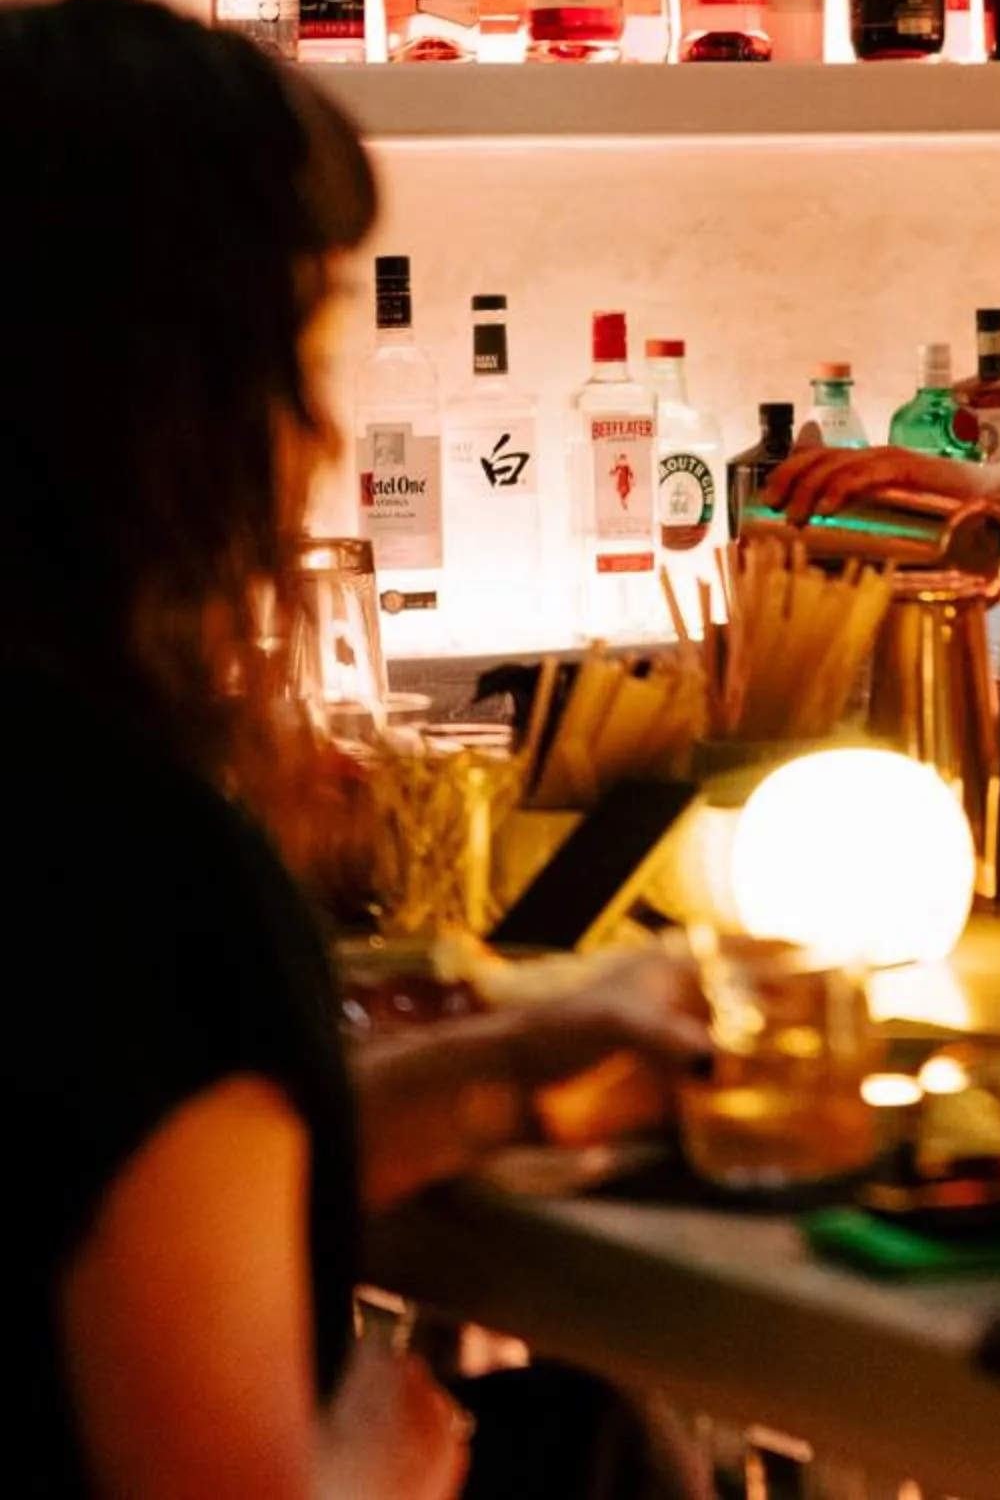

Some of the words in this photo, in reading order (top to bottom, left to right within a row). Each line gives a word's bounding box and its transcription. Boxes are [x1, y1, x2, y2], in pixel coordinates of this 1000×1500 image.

[592, 419, 654, 441] BEEFEATER
[480, 432, 531, 488] 白
[397, 474, 427, 495] One
